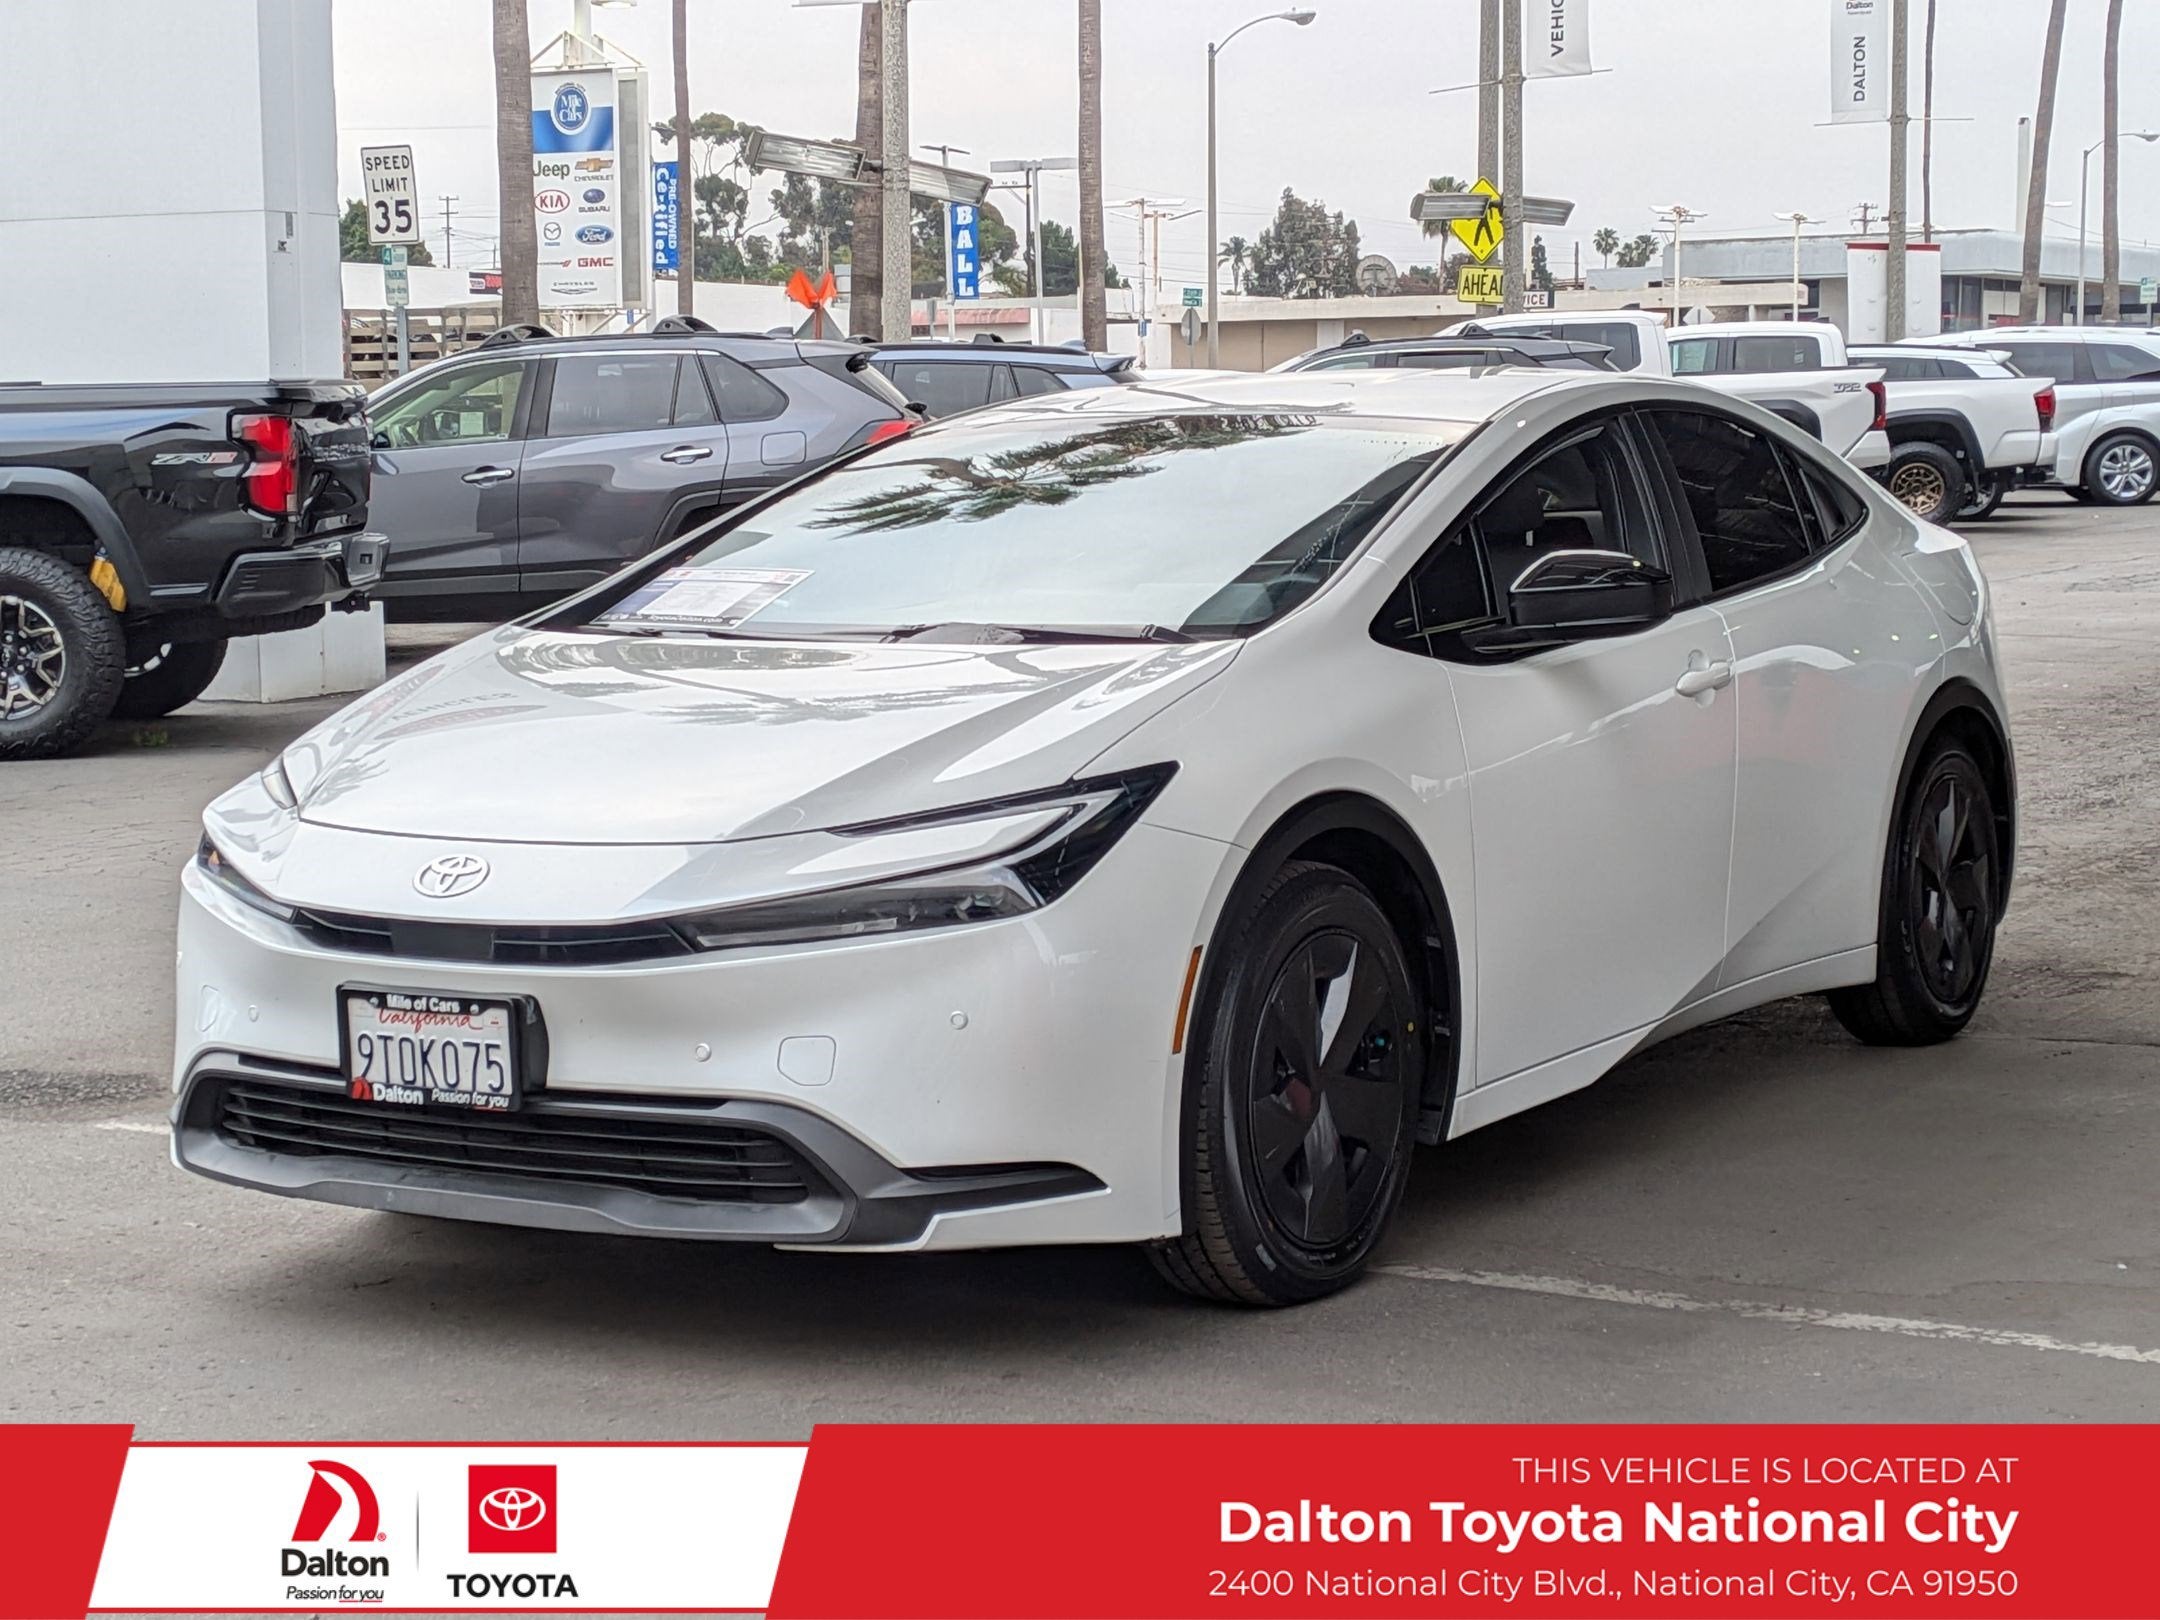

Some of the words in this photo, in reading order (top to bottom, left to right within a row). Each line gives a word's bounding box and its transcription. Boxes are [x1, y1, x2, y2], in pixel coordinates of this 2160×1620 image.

[1846, 1, 1873, 10] Dalton
[1853, 36, 1866, 102] DALTON
[366, 155, 410, 171] SPEED
[533, 160, 570, 180] Jeep
[371, 177, 408, 193] LIMIT
[540, 195, 564, 208] KIA
[374, 199, 412, 234] 35
[668, 178, 678, 250] PRE-OWNED
[582, 227, 607, 242] Ford
[957, 206, 974, 296] BALL
[577, 257, 614, 268] GMC
[387, 994, 412, 1010] Mile
[413, 999, 428, 1010] of
[429, 998, 460, 1013] Cars
[373, 1083, 424, 1105] Dalton
[431, 1088, 471, 1105] Passion
[472, 1092, 488, 1106] for
[488, 1095, 509, 1109] you
